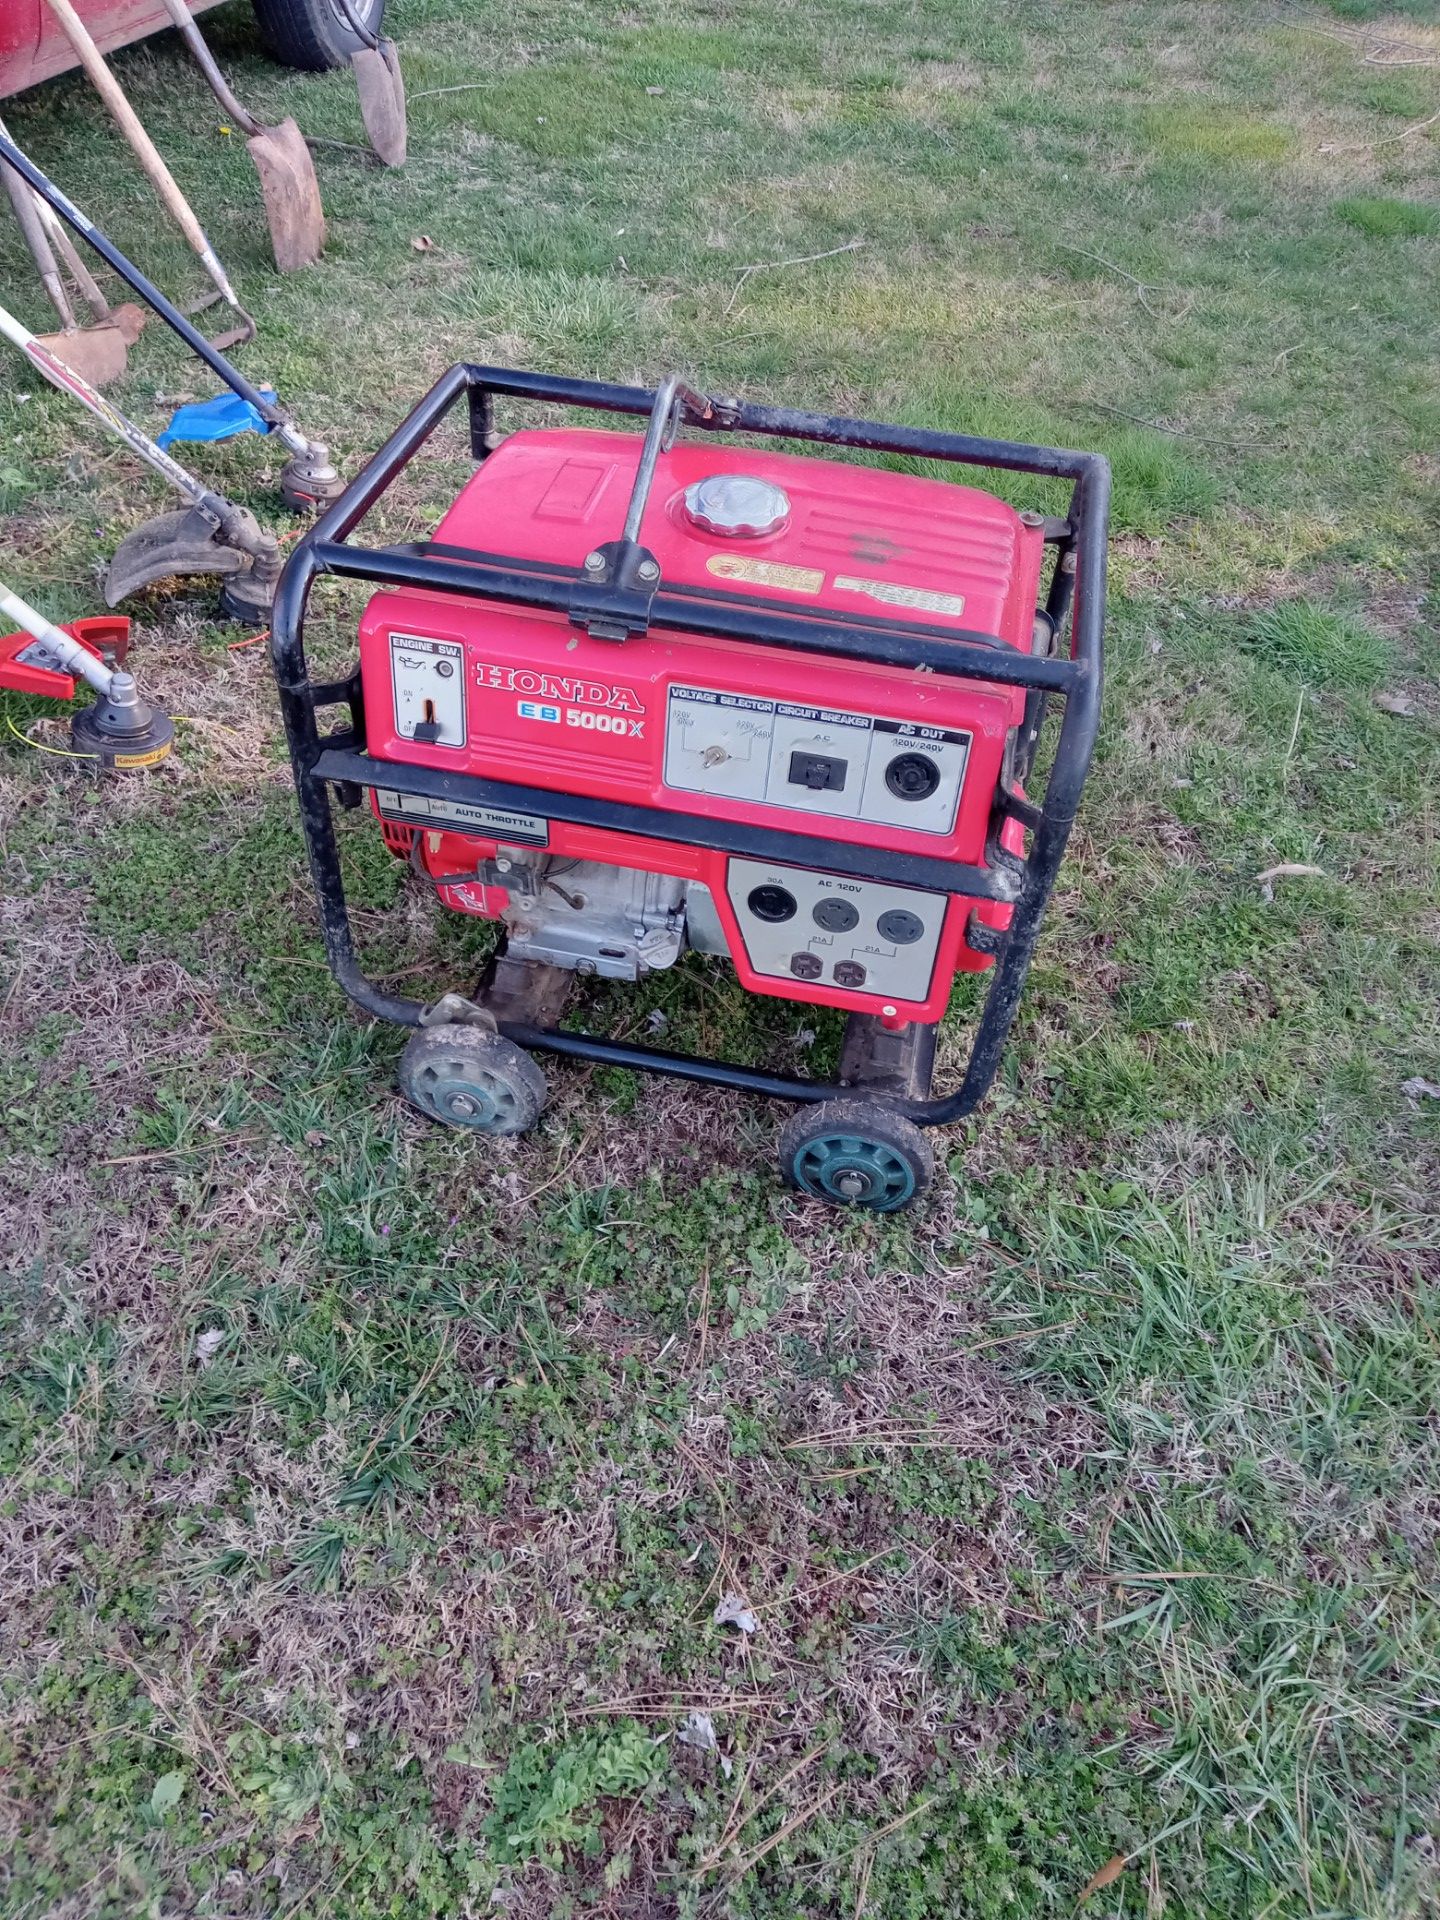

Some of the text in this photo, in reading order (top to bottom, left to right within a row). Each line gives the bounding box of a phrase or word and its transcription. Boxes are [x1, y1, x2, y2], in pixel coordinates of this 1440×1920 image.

[392, 637, 461, 657] ENGINE SW.
[476, 662, 646, 714] HONDA
[671, 687, 772, 712] VOLTAGE SELECTOR
[565, 708, 645, 739] 5000X
[777, 705, 870, 728] CIRCUIT BREAKER
[812, 733, 831, 742] AC
[898, 723, 946, 741] AC OUT
[455, 807, 482, 819] AUTO
[485, 813, 536, 828] THROTTLE
[818, 879, 862, 893] AC 120V
